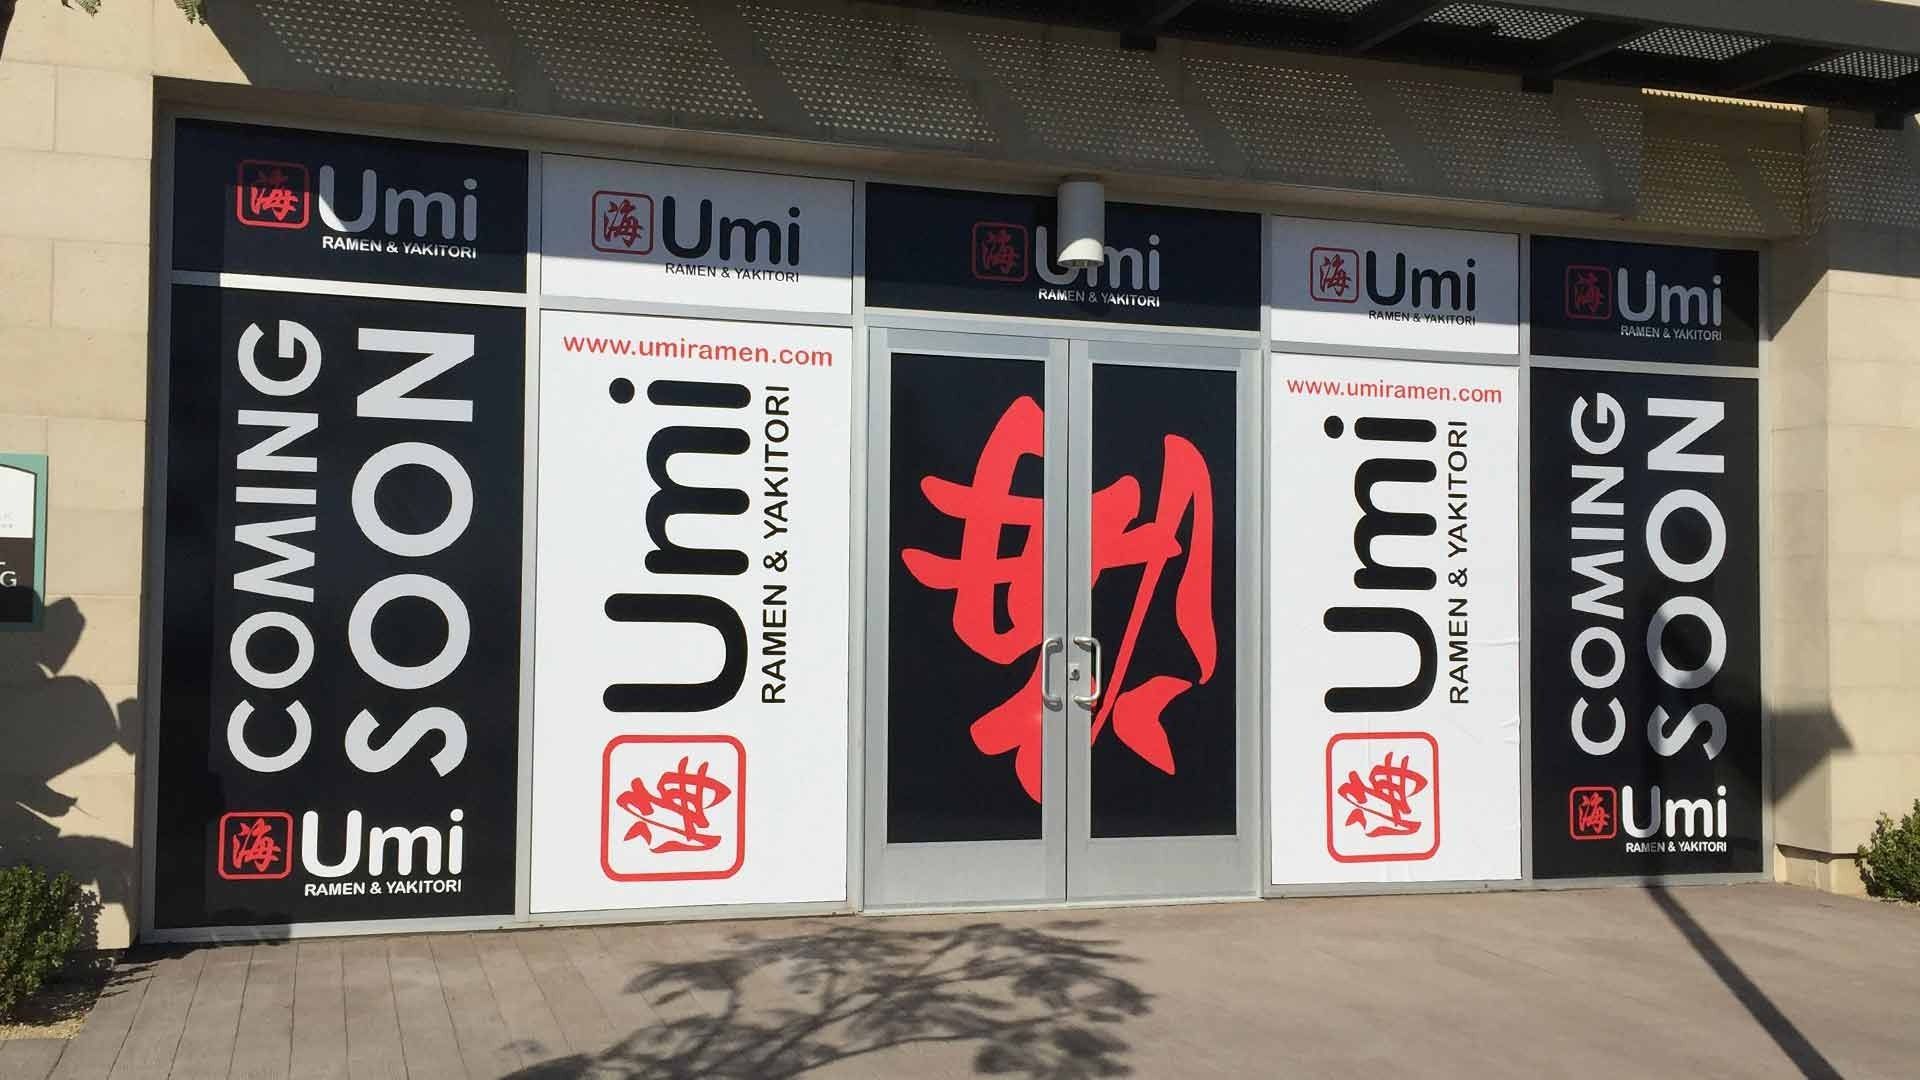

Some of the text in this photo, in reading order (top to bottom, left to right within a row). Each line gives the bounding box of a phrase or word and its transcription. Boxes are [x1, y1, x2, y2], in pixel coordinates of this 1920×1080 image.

[319, 165, 478, 241] Umi
[662, 195, 800, 266] Umi
[322, 236, 477, 259] RAMEN & YAKITORI
[665, 263, 799, 283] RAMEN & YAKITORI
[1038, 288, 1160, 307] RAMEN & YAKITORI
[1366, 250, 1476, 311] Umi
[1618, 267, 1722, 326] Umi
[1369, 310, 1475, 326] RAMEN & YAKITORI
[1621, 325, 1722, 341] RAMEN & YAKITORI
[563, 335, 834, 368] www.umiramen.com
[1287, 377, 1502, 404] www.umiramen.com
[227, 319, 322, 773] COMING
[344, 328, 475, 777] SOON
[603, 377, 752, 712] Umi
[762, 385, 790, 705] RAMEN & YAKITORI
[1323, 415, 1438, 713] Umi
[1448, 421, 1469, 704] RAMEN & YAKITORI
[1570, 392, 1626, 756] COMING
[1645, 398, 1727, 761] SOON
[1622, 785, 1727, 838] Umi
[301, 808, 464, 878] Umi
[1625, 841, 1727, 853] RAMEN & YAKITORI
[304, 879, 461, 896] RAMEN & YAKITORI
